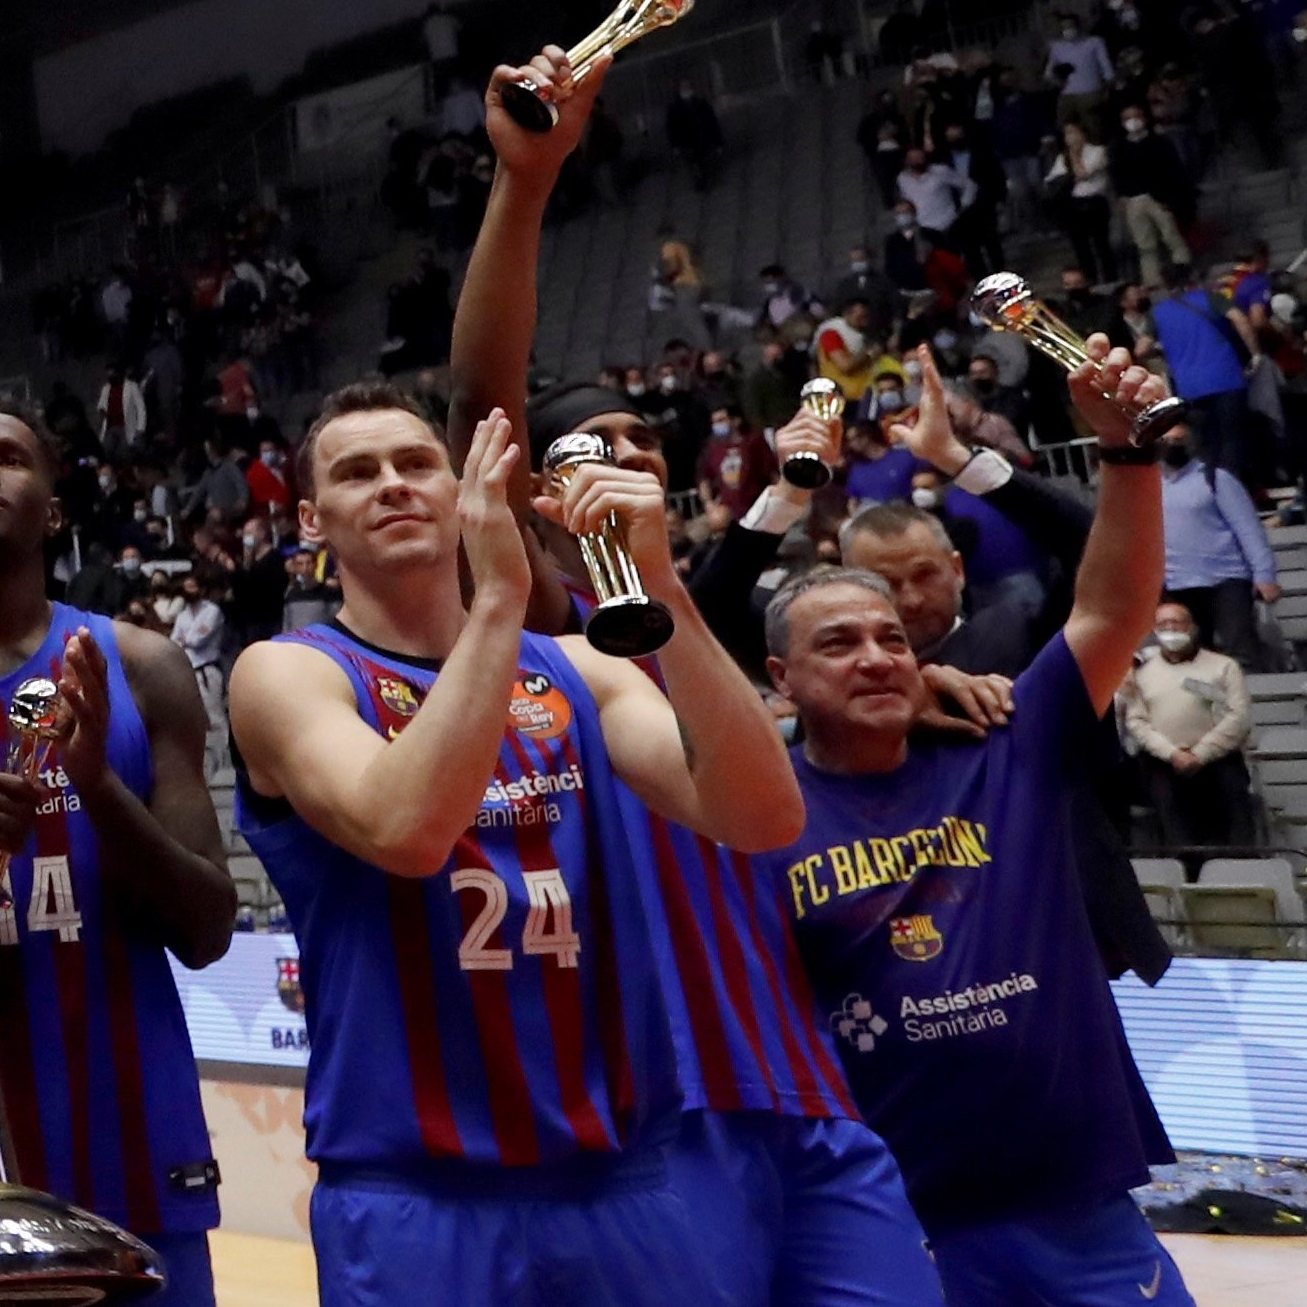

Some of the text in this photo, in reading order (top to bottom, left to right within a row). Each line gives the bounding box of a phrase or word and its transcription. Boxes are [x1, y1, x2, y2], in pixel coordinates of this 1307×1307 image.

[483, 764, 584, 803] sistènci
[477, 797, 562, 828] anitària
[788, 853, 830, 921] FC
[449, 868, 581, 971] 24
[271, 1027, 310, 1051] BAR
